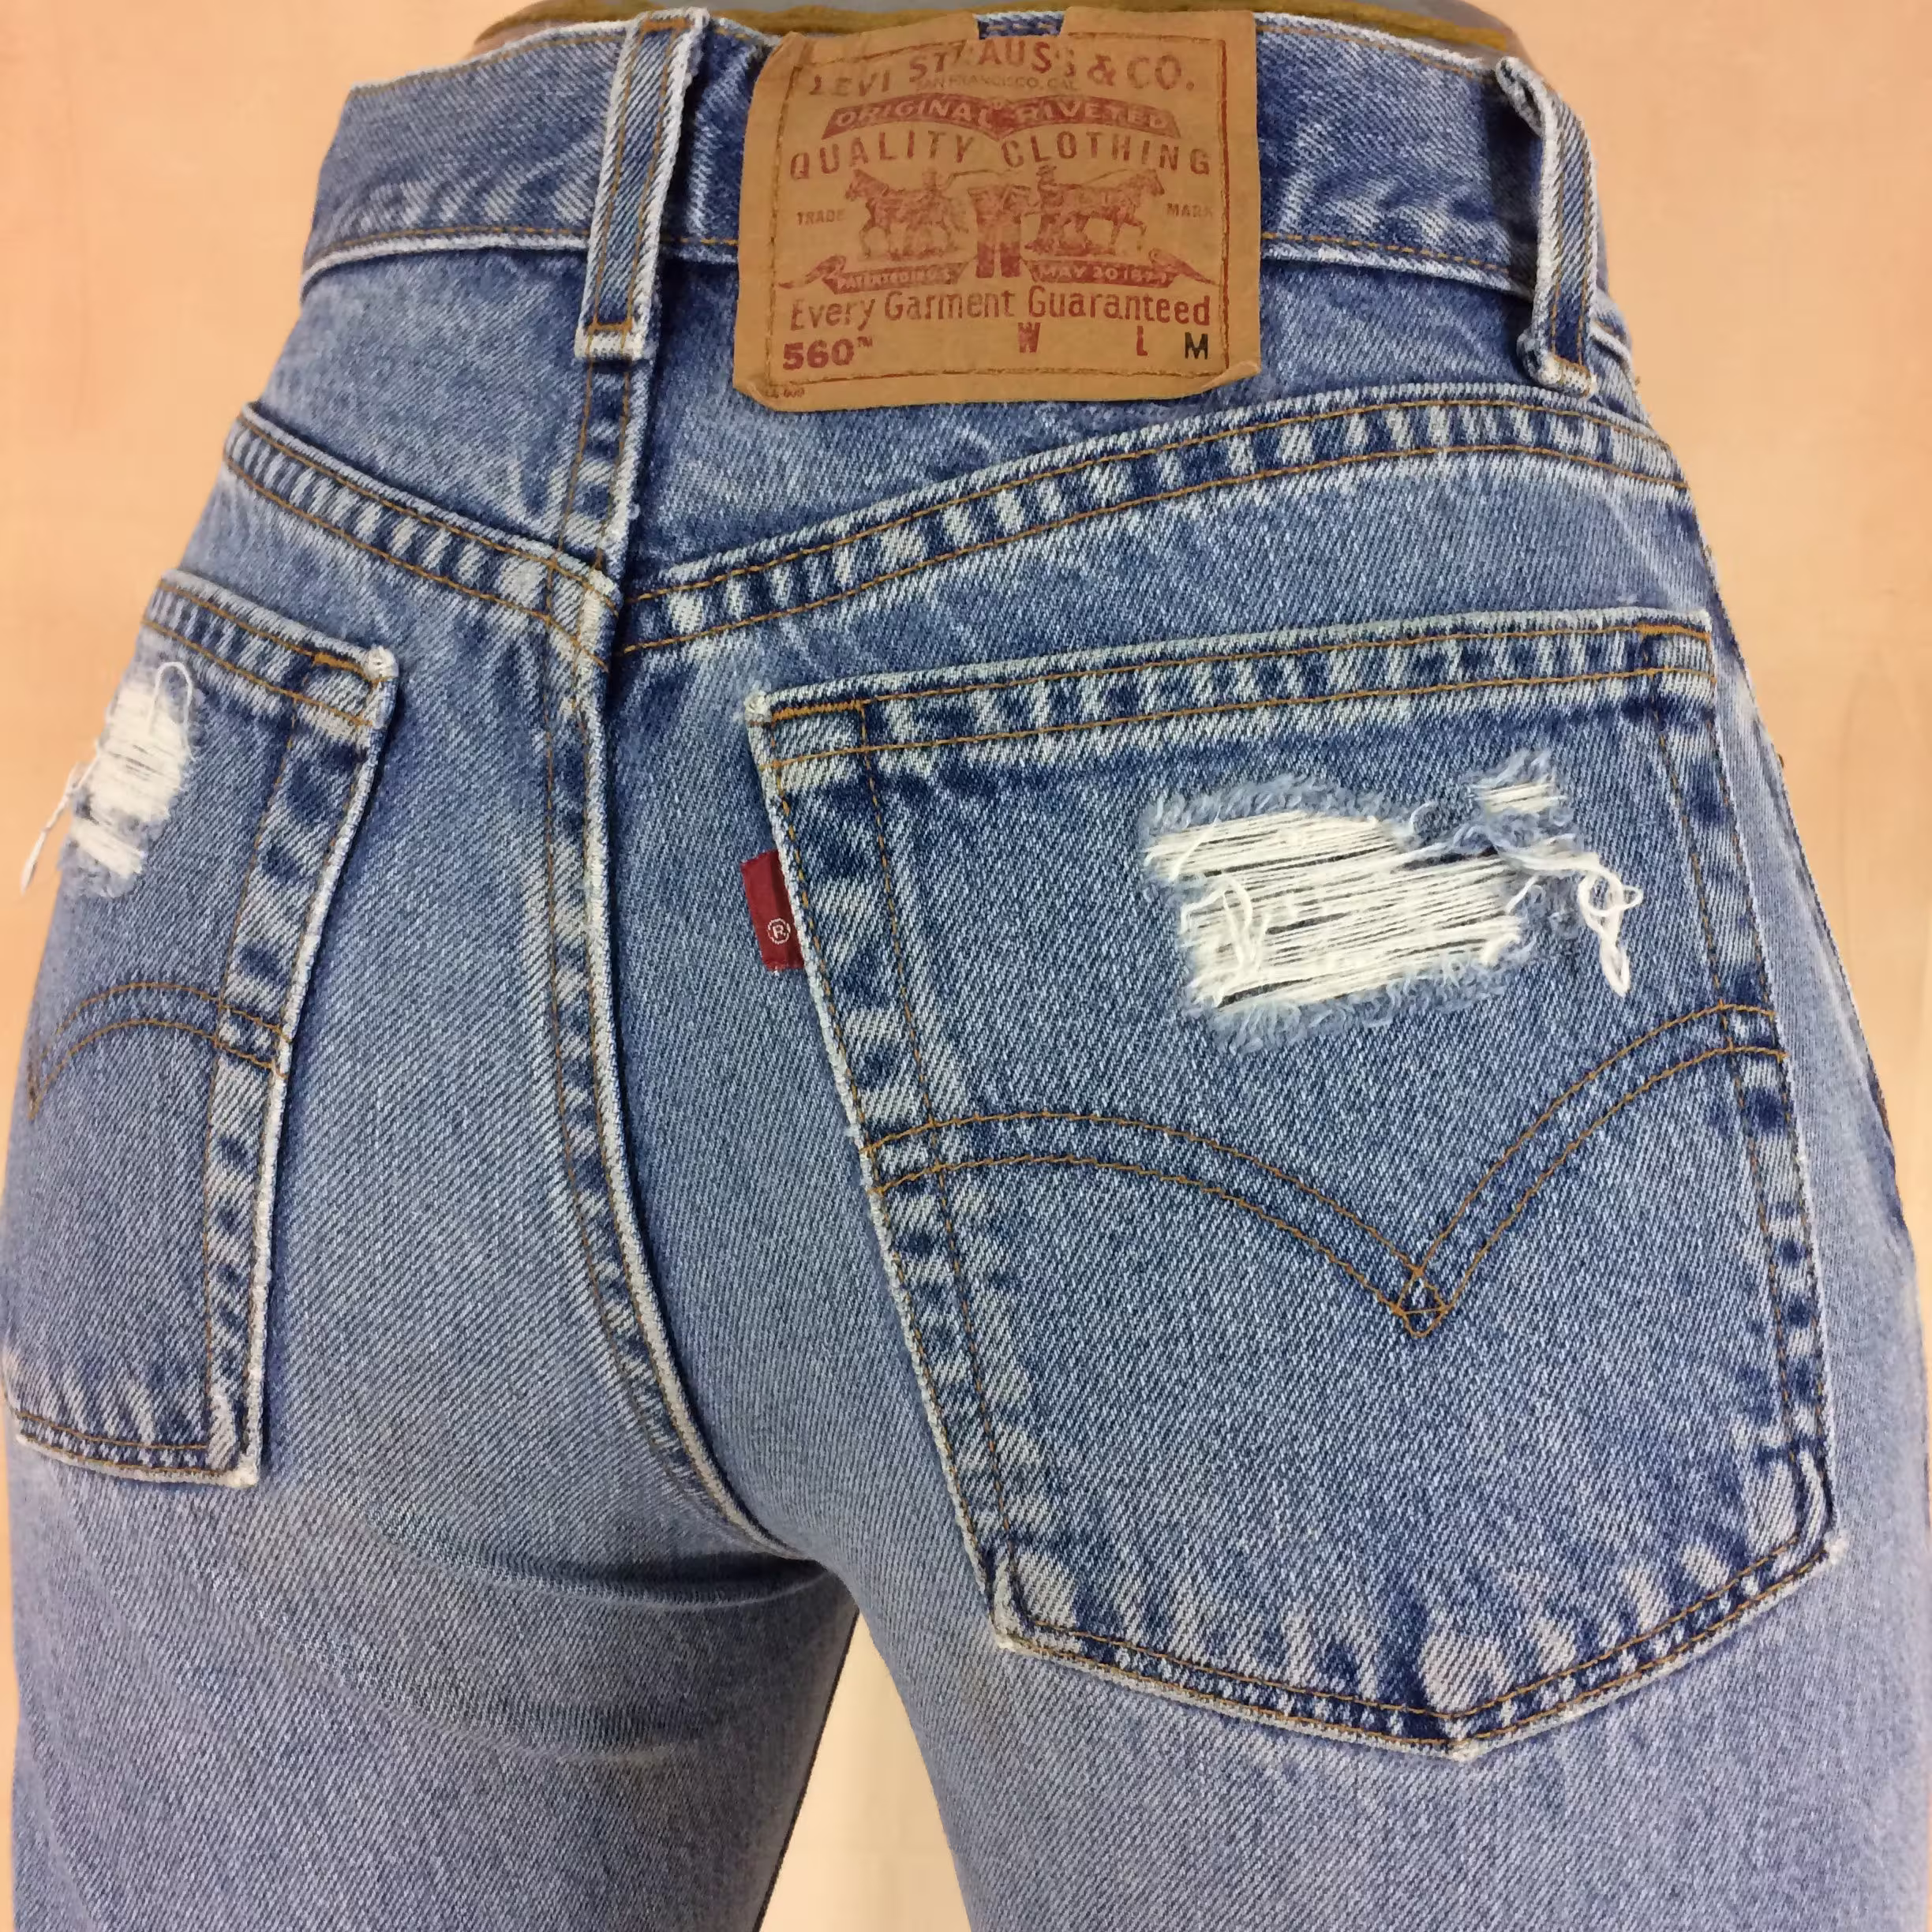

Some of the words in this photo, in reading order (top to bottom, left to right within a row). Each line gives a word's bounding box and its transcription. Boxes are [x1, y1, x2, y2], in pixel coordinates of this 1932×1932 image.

[1087, 53, 1117, 87] &
[1126, 54, 1195, 91] CO.
[790, 129, 975, 181] QUALITY
[1000, 130, 1211, 175] CLOTHING
[796, 208, 846, 226] TRADE
[790, 298, 876, 331] Every
[884, 290, 1016, 320] Garment
[1028, 284, 1211, 327] Guaranteed
[1018, 321, 1042, 354] W
[1136, 325, 1148, 357] L
[1184, 331, 1208, 360] M
